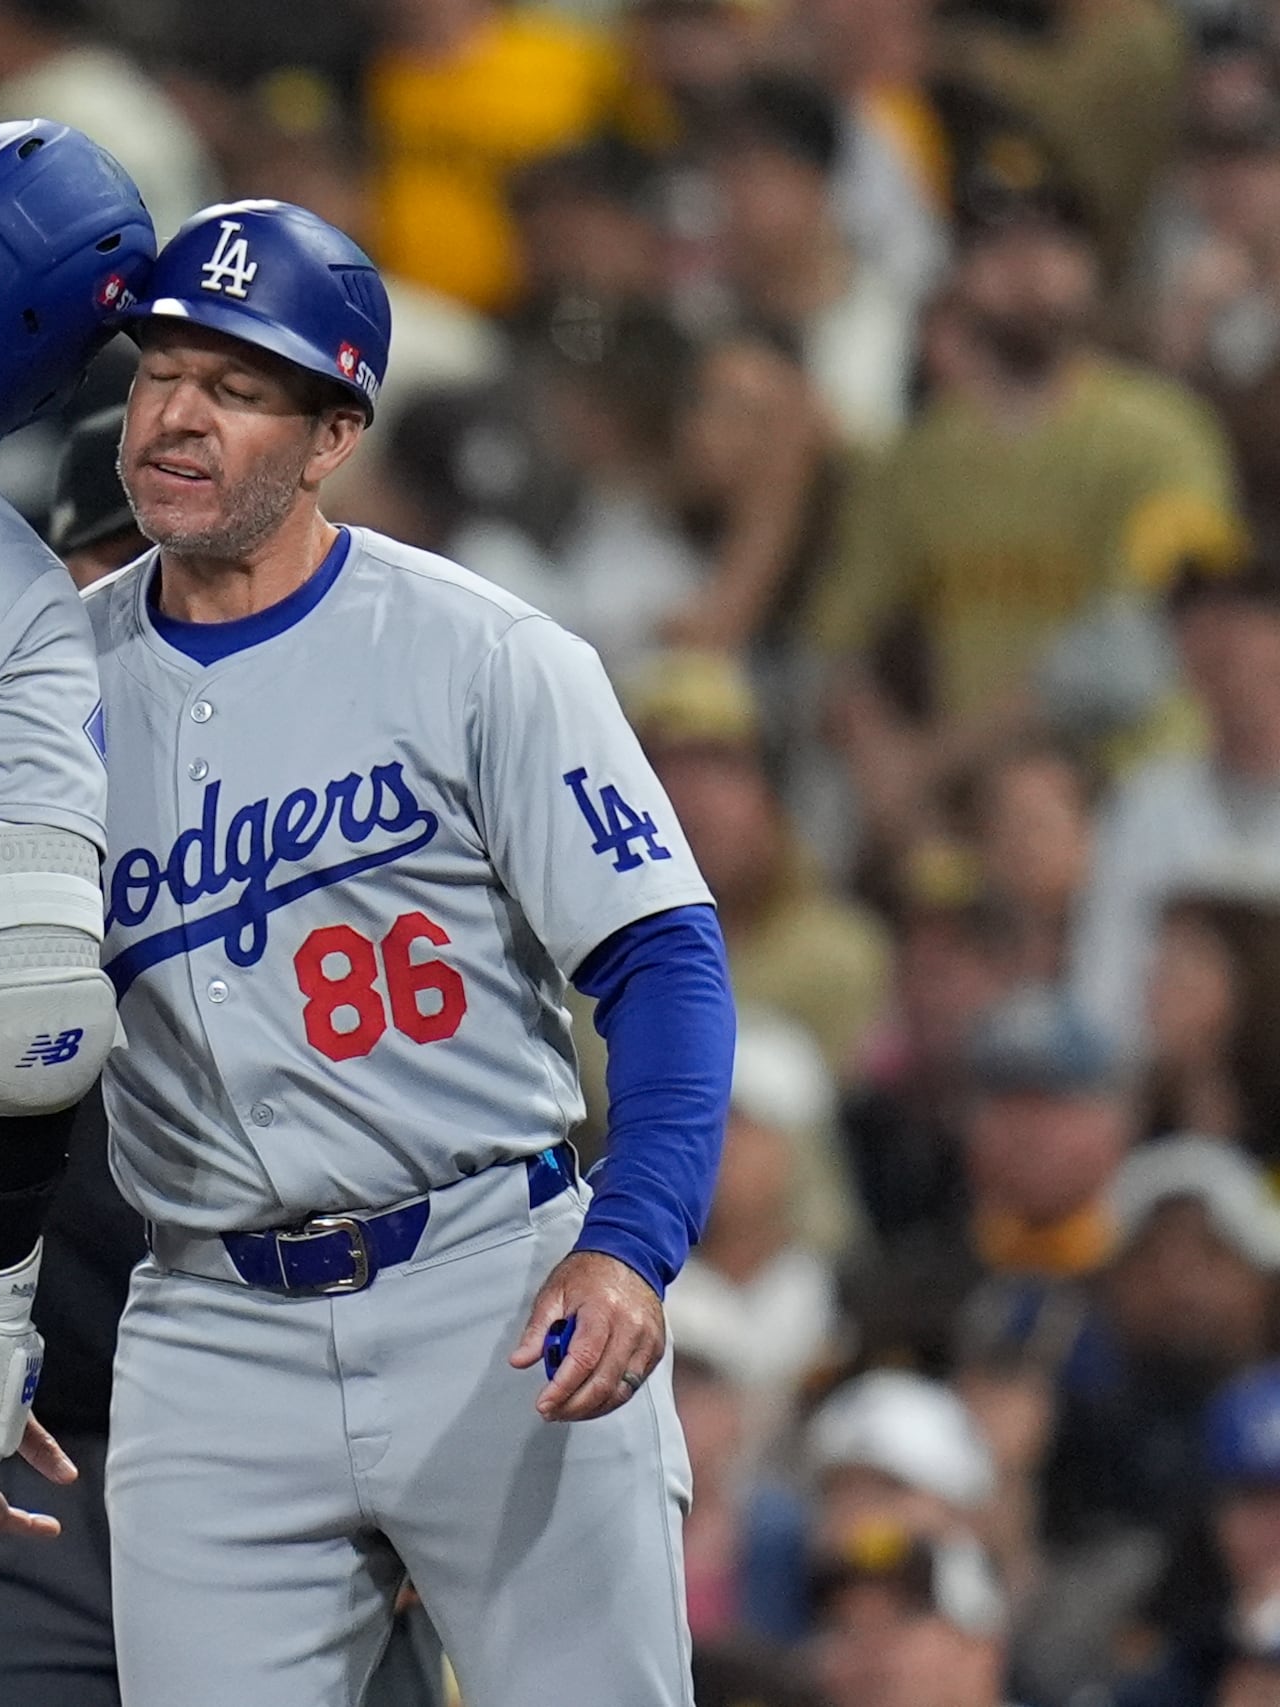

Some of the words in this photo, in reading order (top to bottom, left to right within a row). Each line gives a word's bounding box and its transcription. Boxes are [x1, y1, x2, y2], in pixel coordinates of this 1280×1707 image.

[201, 219, 258, 299] LA
[103, 761, 438, 970] odgers
[563, 766, 672, 873] LA
[293, 910, 468, 1062] 86
